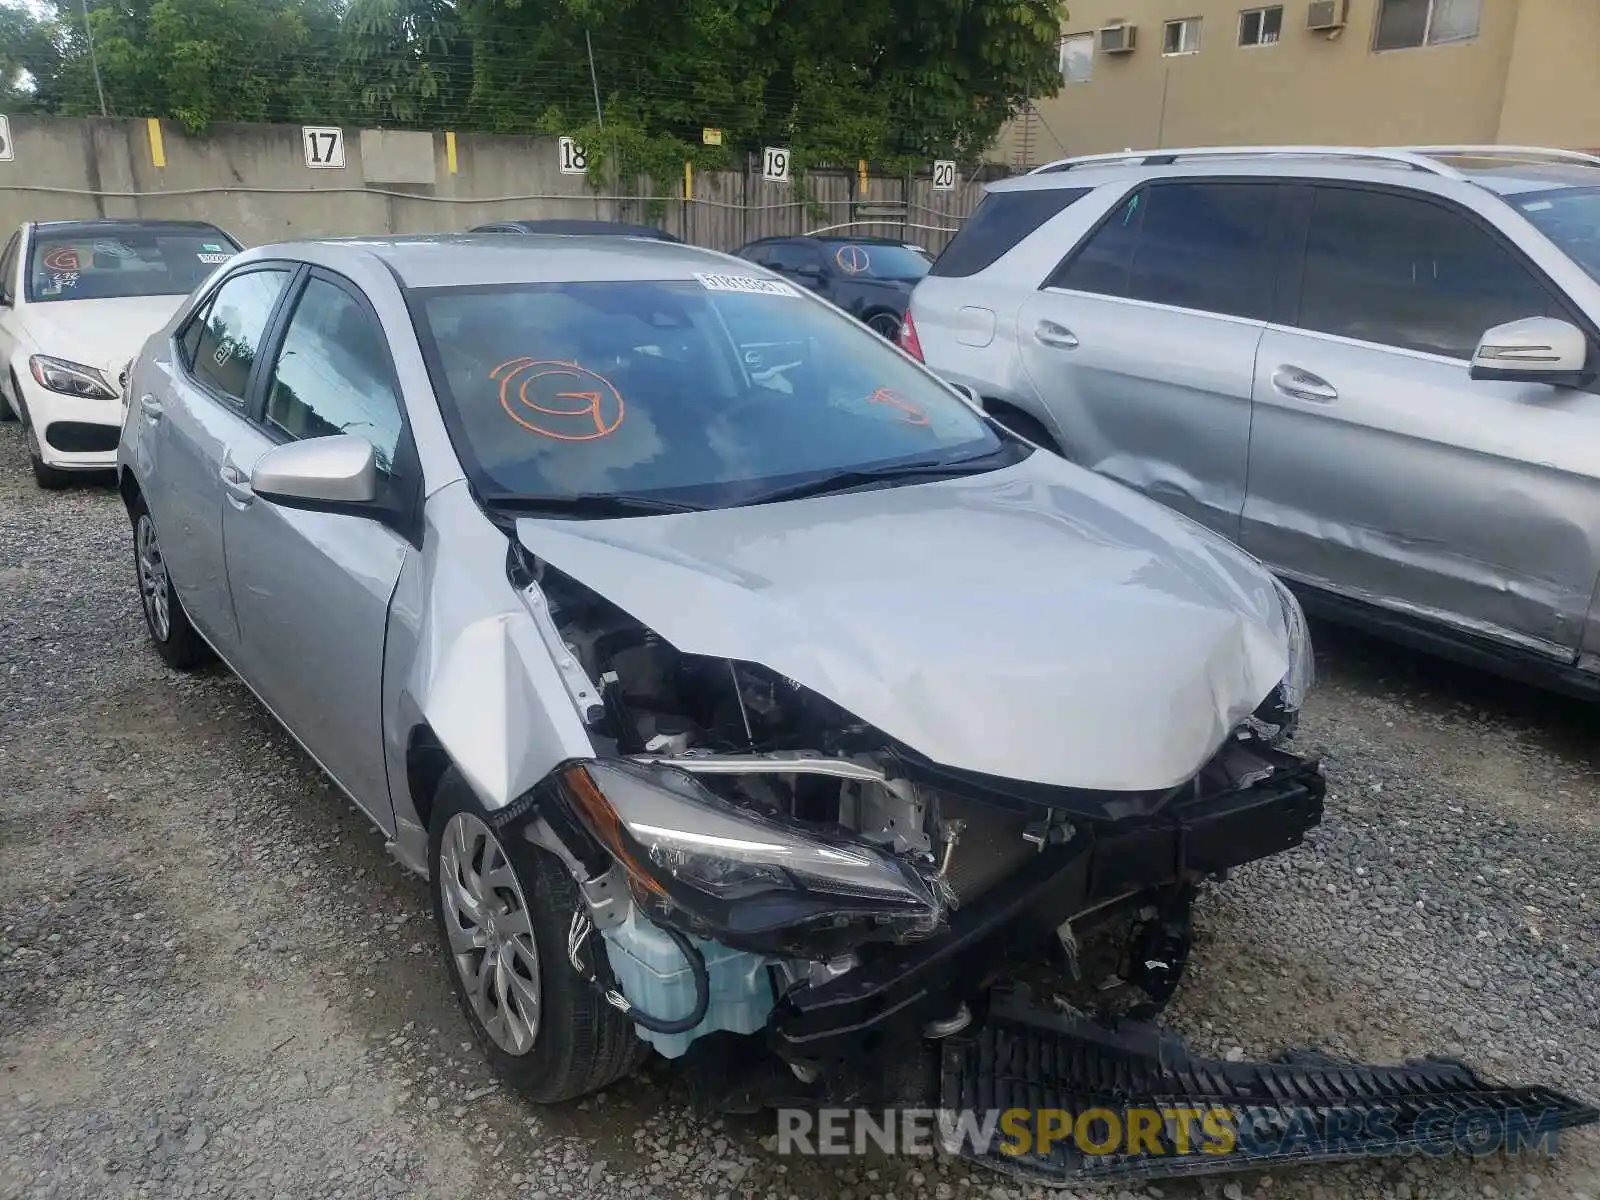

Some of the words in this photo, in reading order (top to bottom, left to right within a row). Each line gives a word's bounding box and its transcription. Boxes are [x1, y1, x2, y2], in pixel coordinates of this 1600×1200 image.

[309, 133, 338, 162] 17
[563, 142, 587, 169] 18
[767, 152, 786, 177] 19
[935, 165, 953, 186] 20
[518, 368, 606, 436] G
